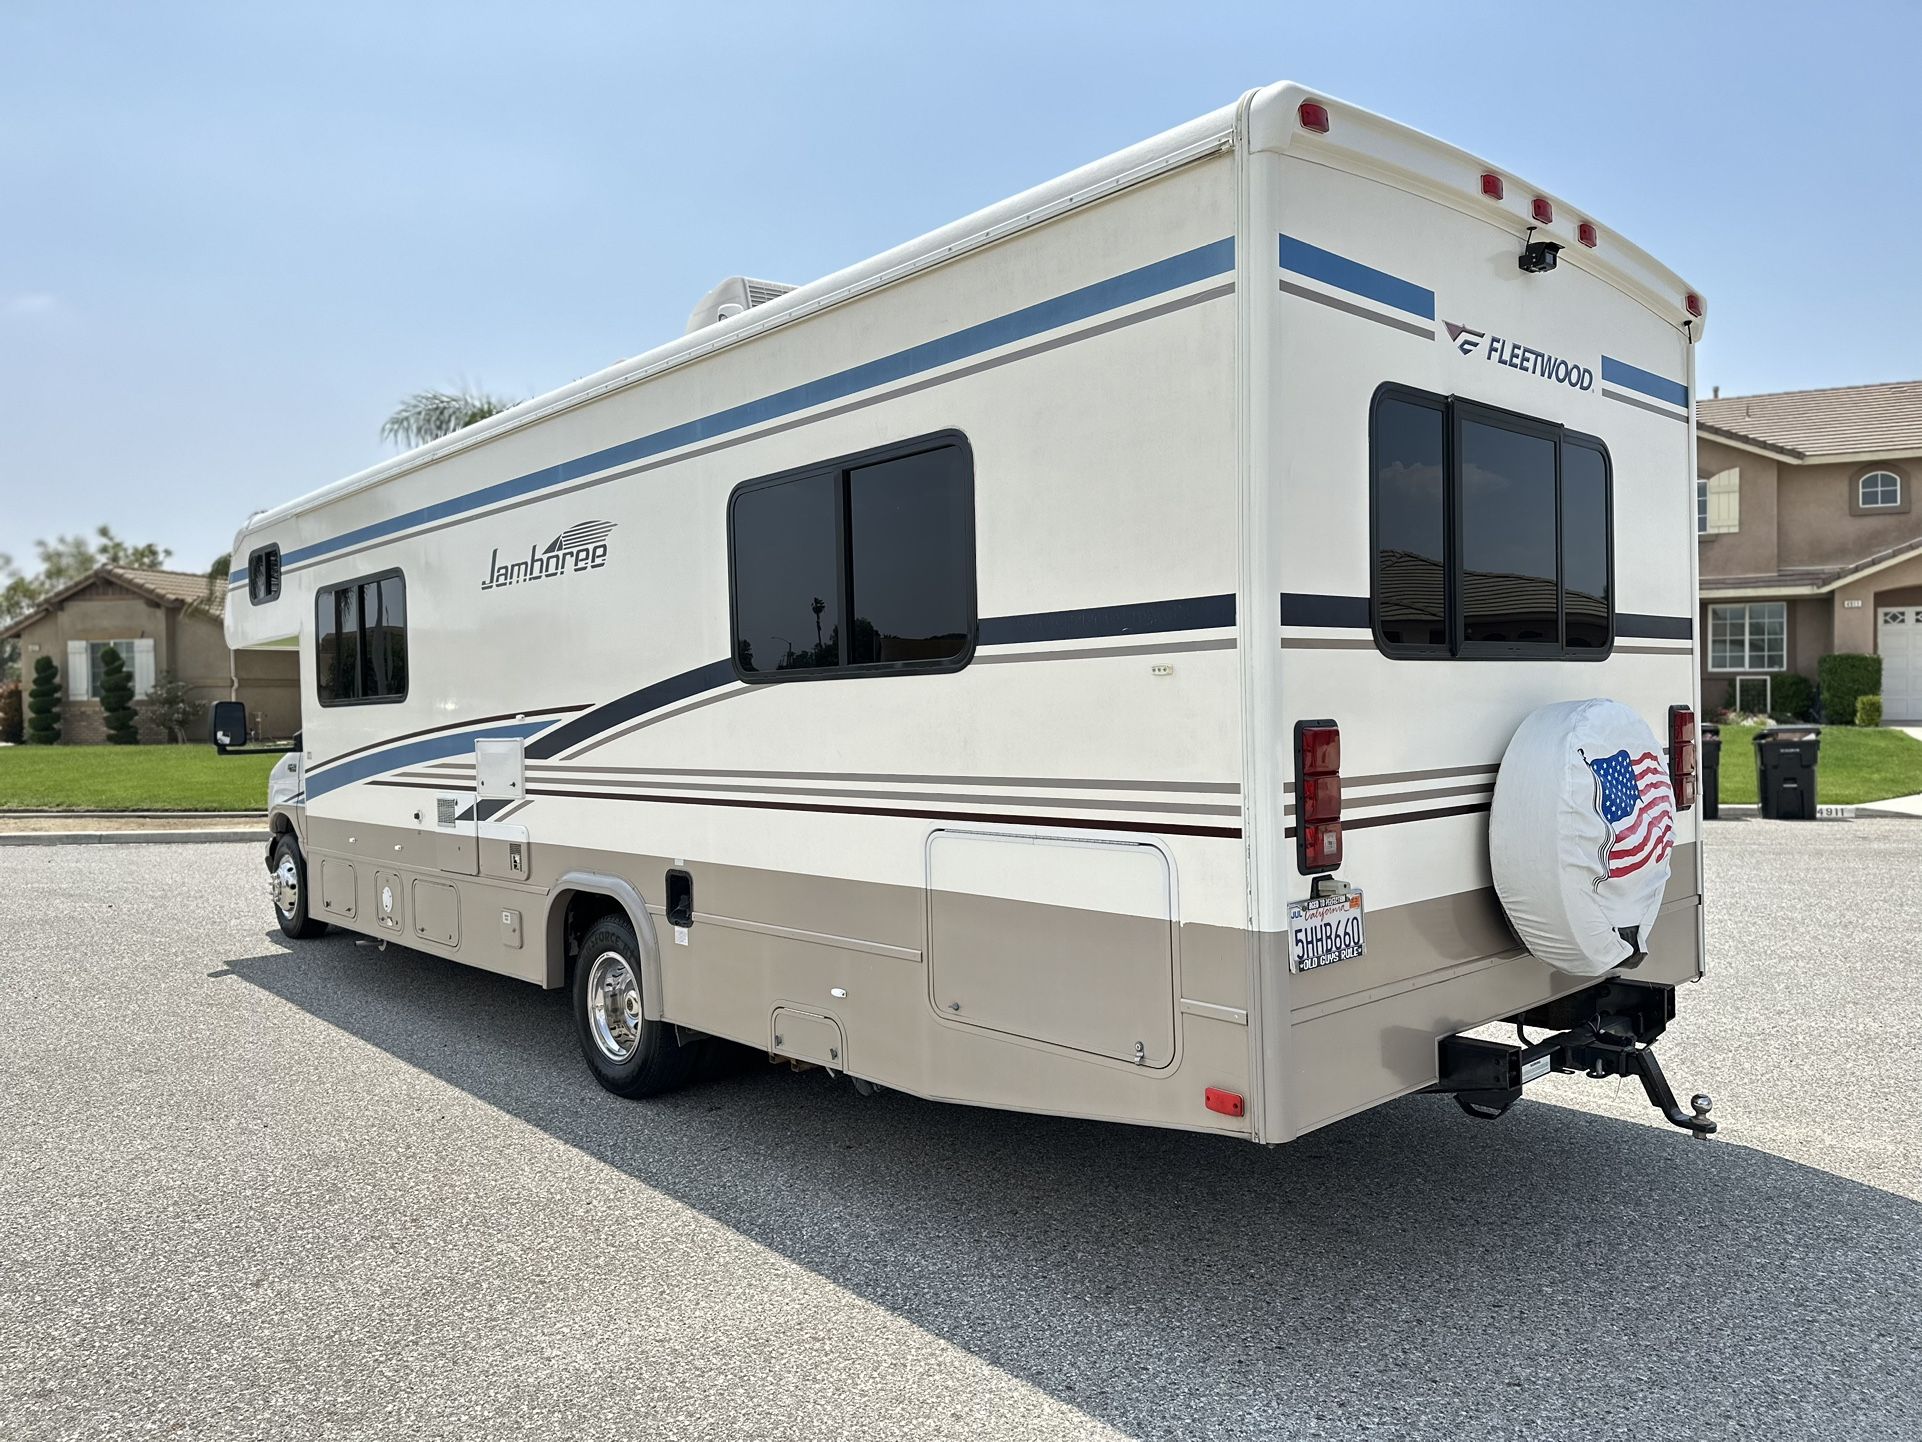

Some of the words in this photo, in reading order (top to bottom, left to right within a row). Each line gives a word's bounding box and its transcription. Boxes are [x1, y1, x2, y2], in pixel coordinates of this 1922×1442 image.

[1486, 336, 1593, 391] FLEETWOOD
[481, 544, 607, 591] Jamboree
[1817, 807, 1844, 816] 4911
[1291, 910, 1302, 919] JUL
[1305, 905, 1350, 921] California
[1294, 916, 1360, 960] 5HHB660
[1304, 958, 1318, 970] OLD
[1320, 953, 1339, 966] GUYS
[1341, 947, 1358, 960] RULE
